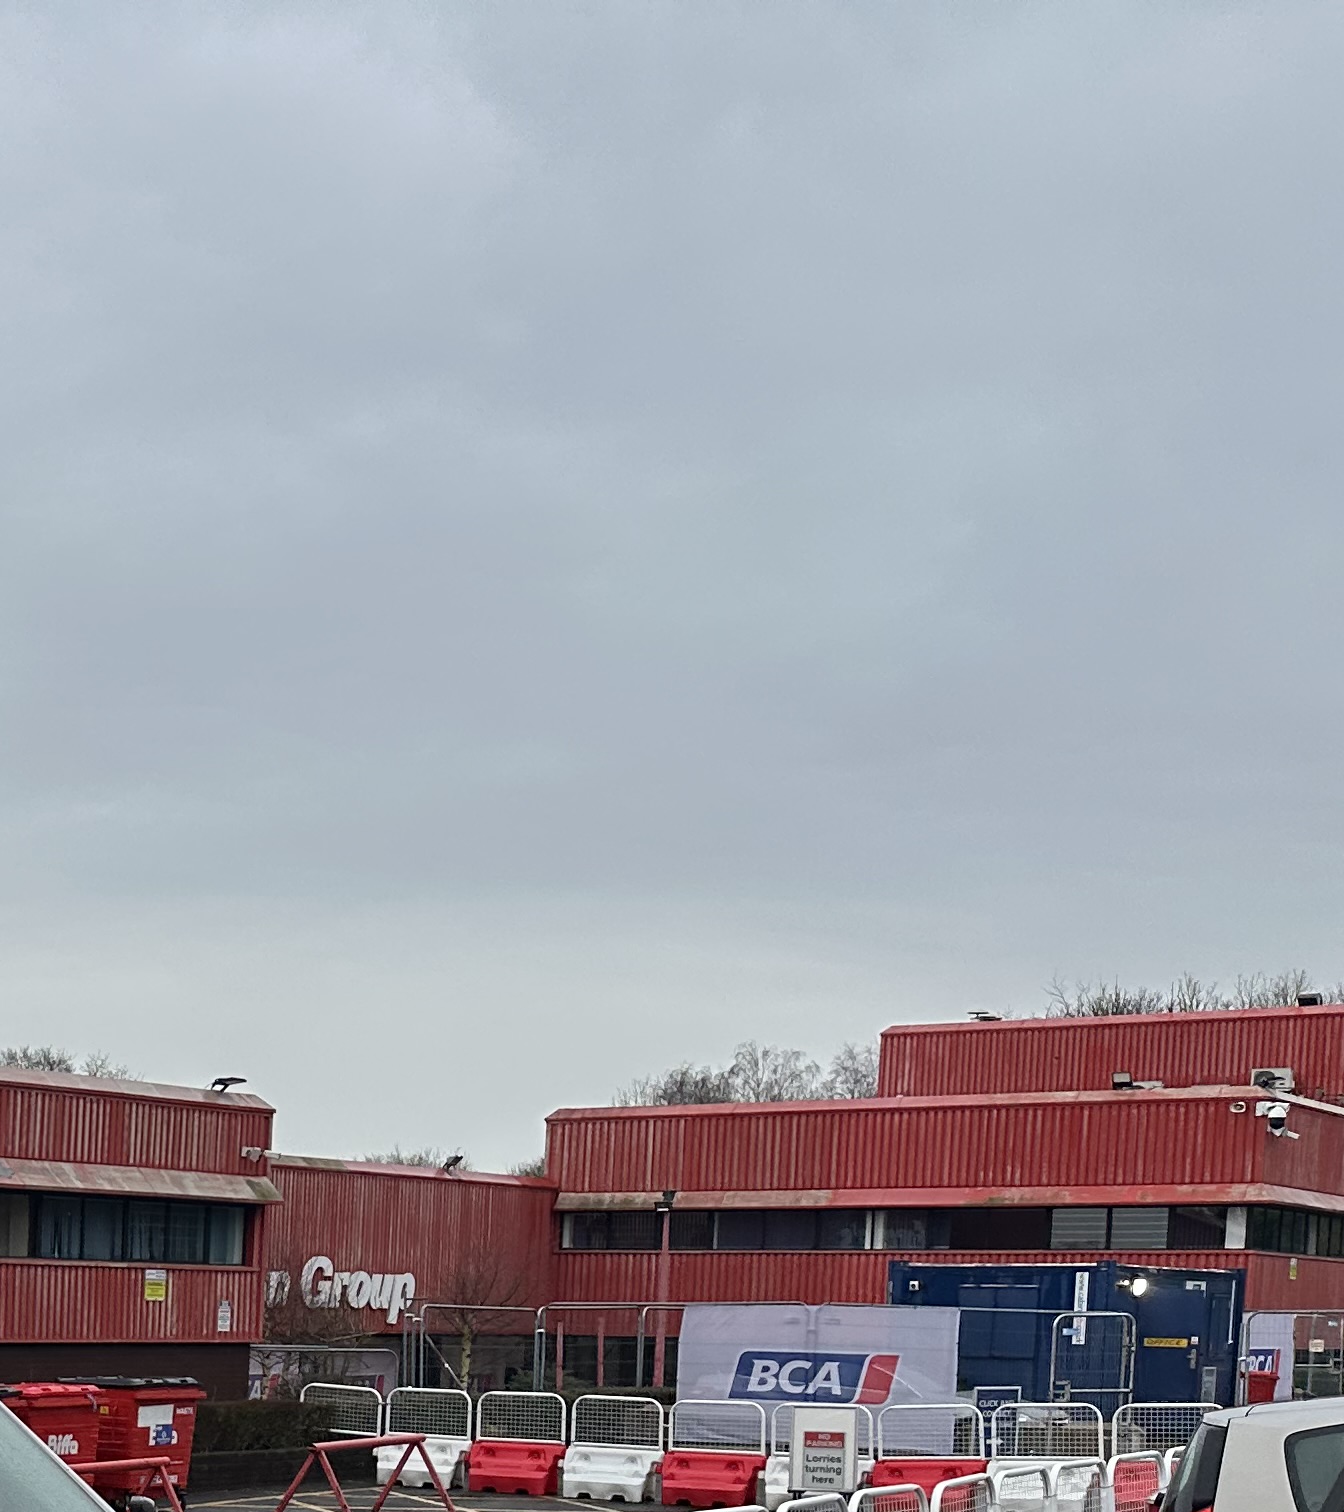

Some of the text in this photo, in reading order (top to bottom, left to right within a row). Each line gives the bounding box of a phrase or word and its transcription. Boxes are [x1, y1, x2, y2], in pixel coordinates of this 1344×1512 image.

[300, 1255, 416, 1325] Group
[746, 1359, 842, 1395] BCA
[47, 1433, 79, 1455] Biffa
[806, 1454, 842, 1463] Lorries
[805, 1465, 842, 1476] turning
[812, 1475, 834, 1484] here
